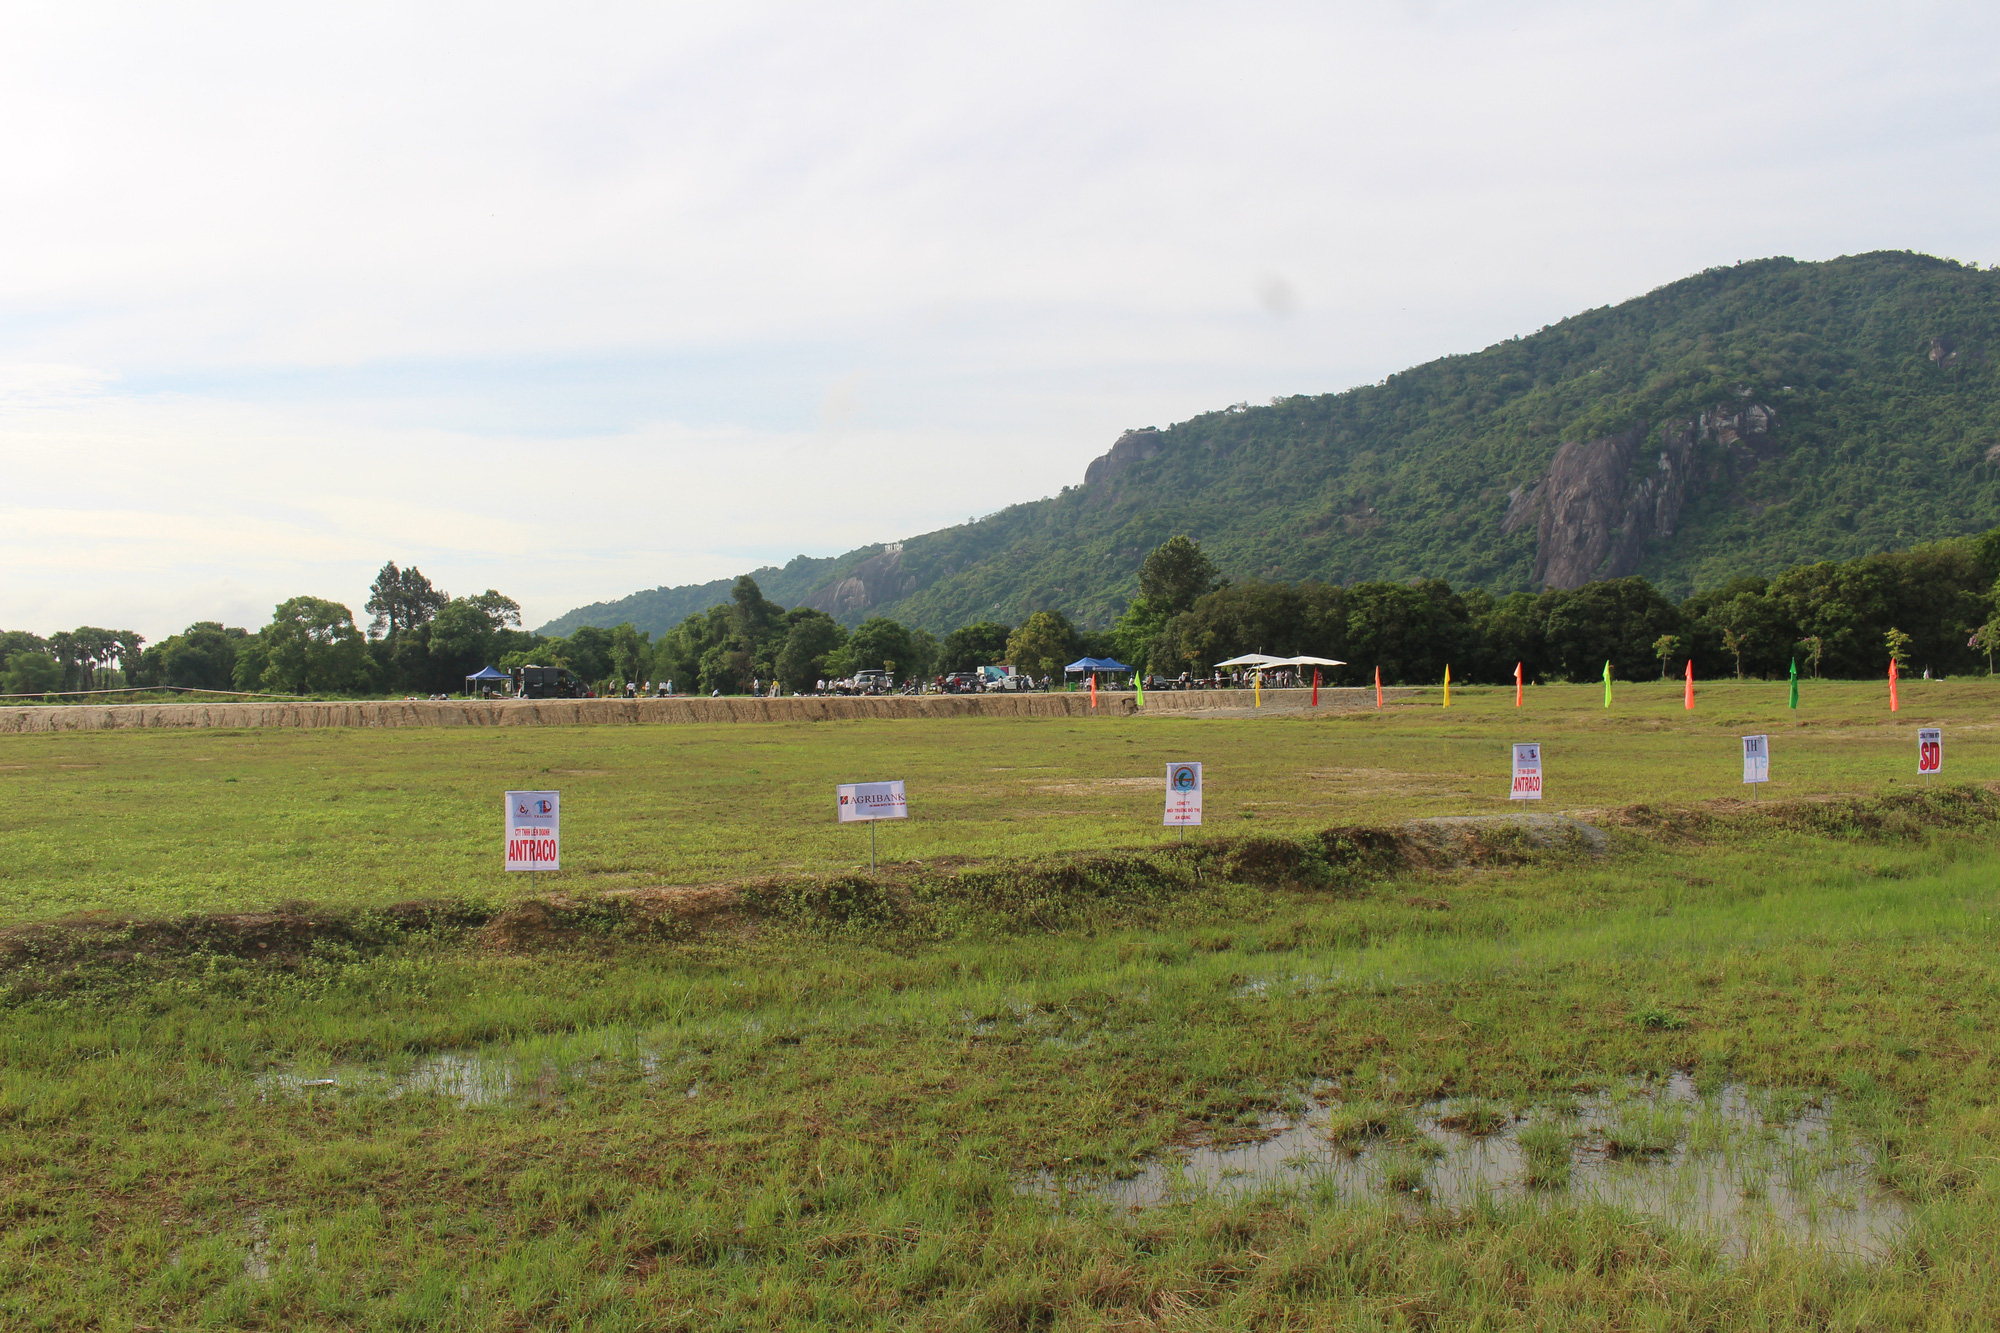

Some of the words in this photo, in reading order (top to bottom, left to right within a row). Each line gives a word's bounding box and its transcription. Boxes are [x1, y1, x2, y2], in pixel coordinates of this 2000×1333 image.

[1745, 739, 1757, 751] TH
[1920, 742, 1940, 770] SD
[1513, 776, 1540, 791] ANTRACO
[850, 793, 905, 804] AGRIBANK
[522, 828, 530, 836] TNHH
[538, 828, 550, 836] DOANH
[508, 839, 556, 861] ANTRACO
